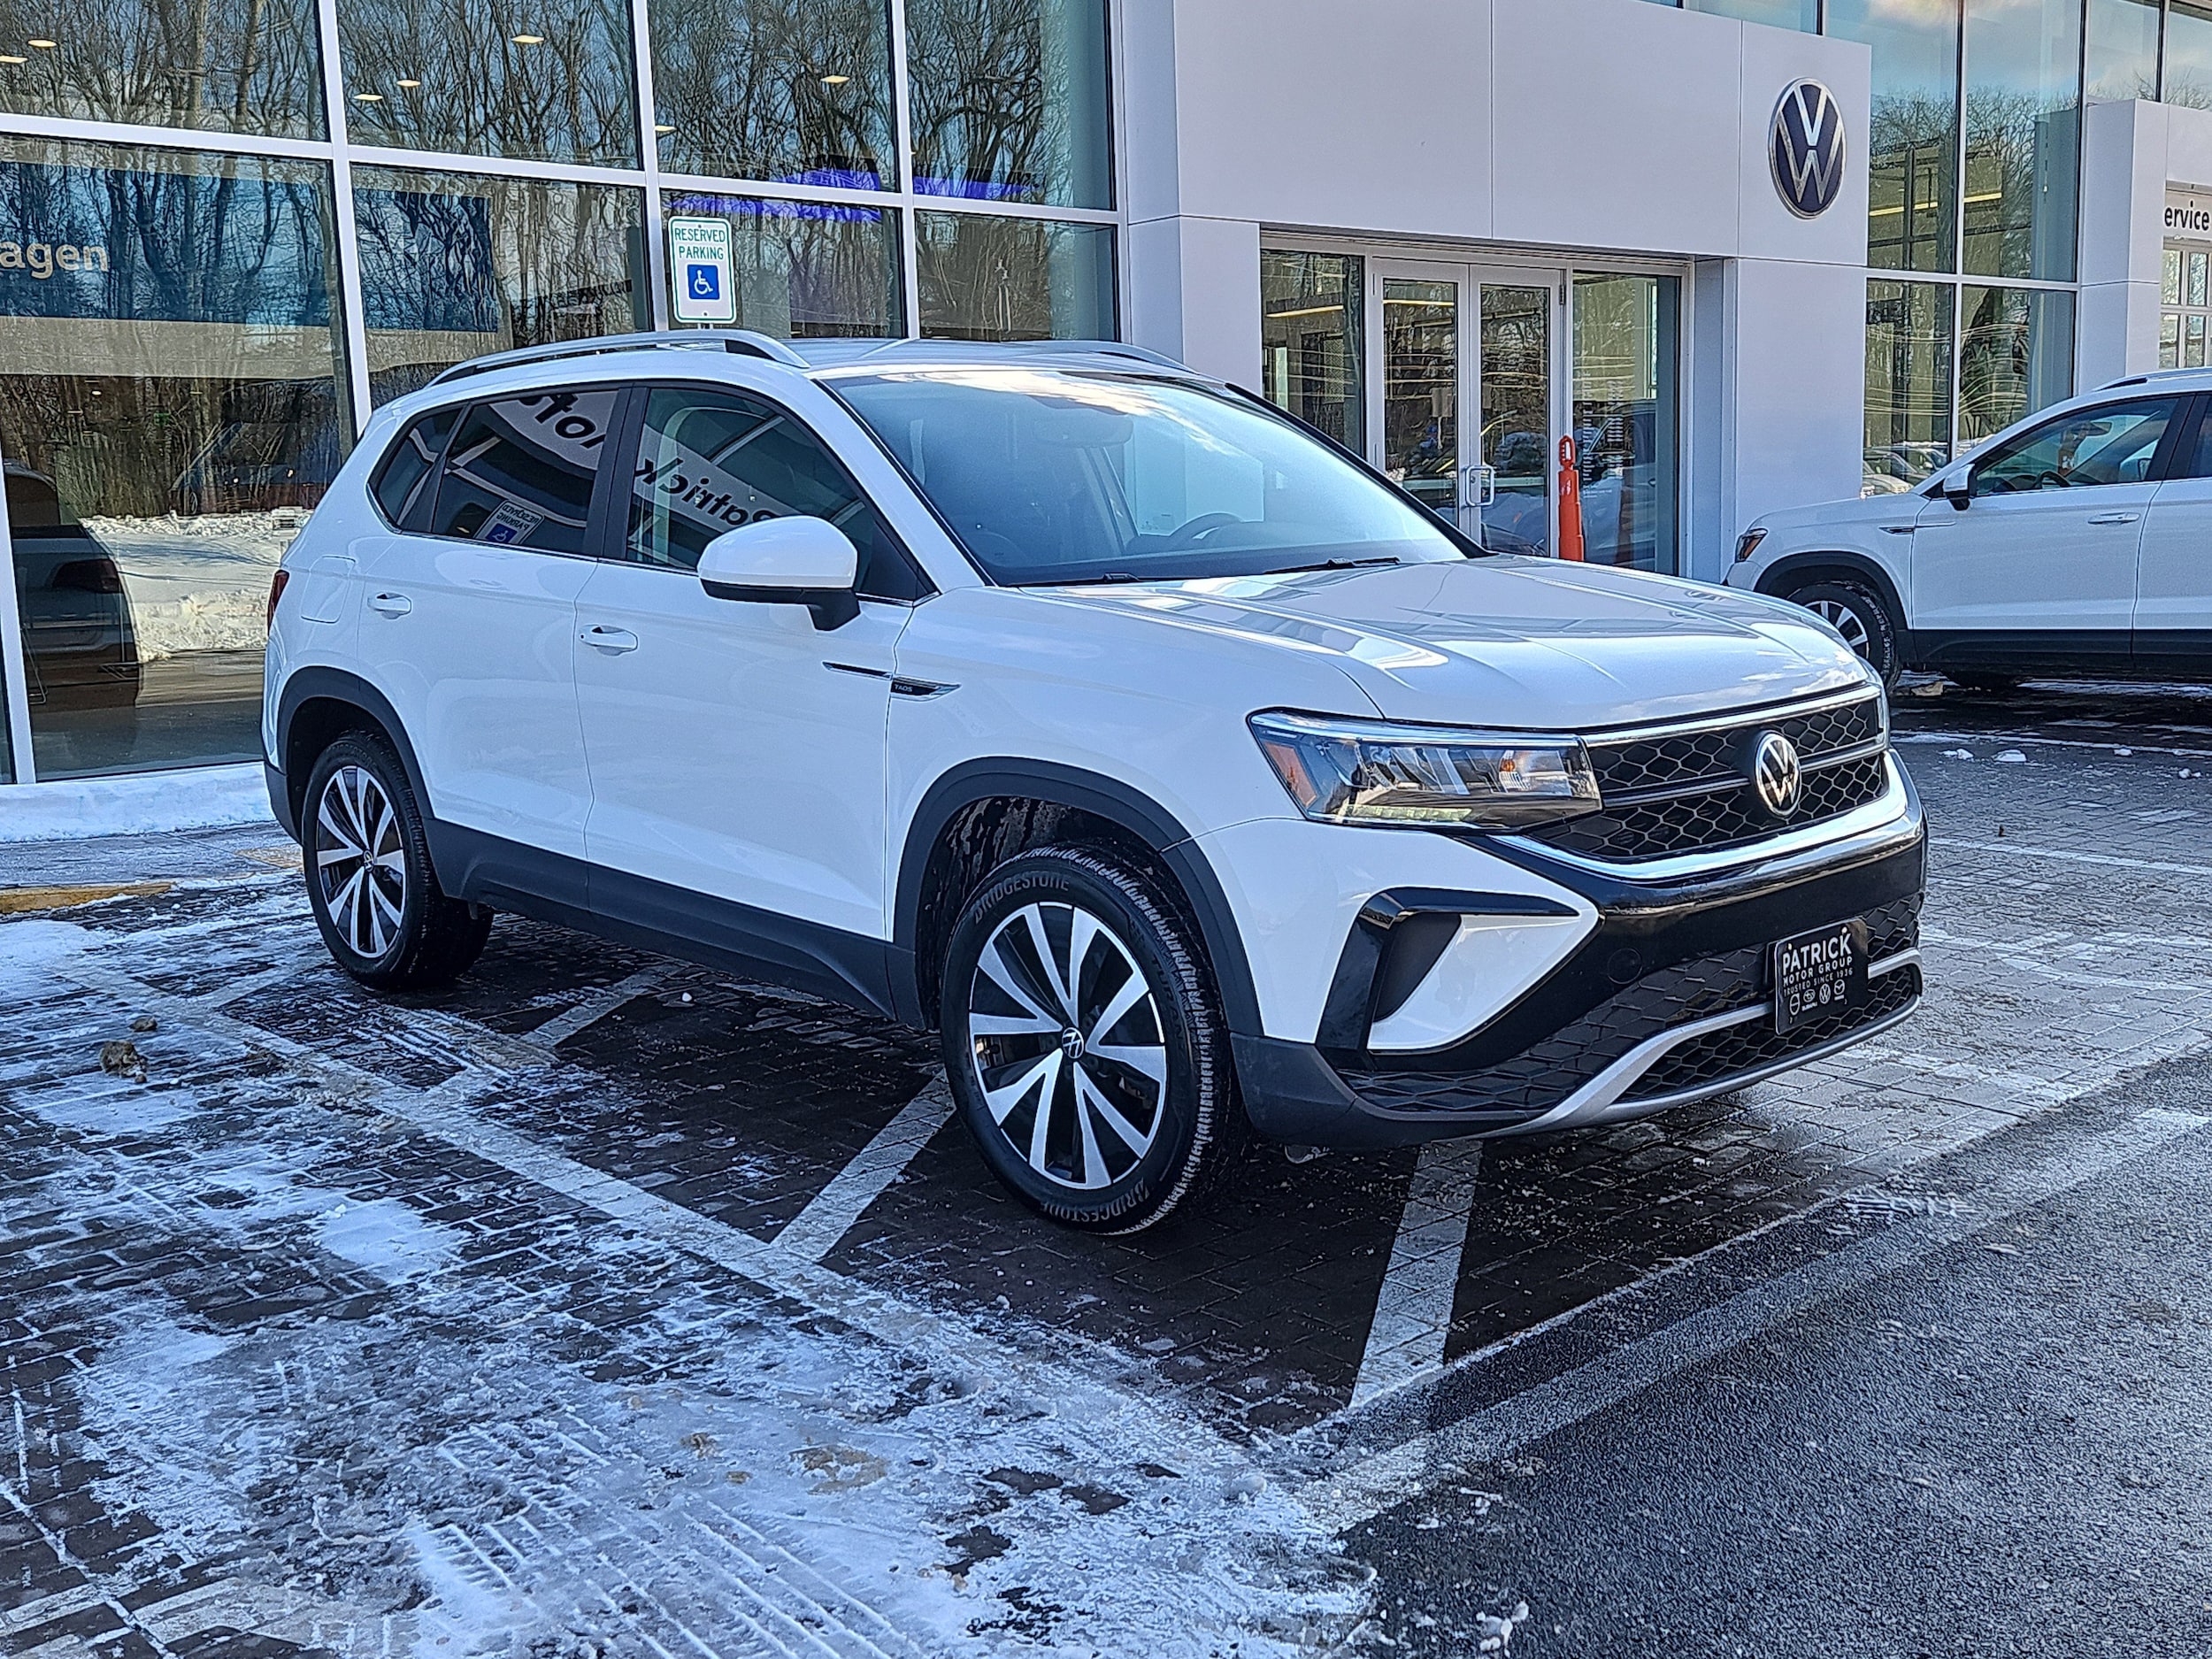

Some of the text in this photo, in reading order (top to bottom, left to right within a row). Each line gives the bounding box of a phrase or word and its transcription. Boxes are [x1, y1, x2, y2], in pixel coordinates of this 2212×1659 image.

[674, 227, 726, 242] RESERVED
[679, 245, 724, 260] PARKING
[974, 870, 1070, 924] BRIDGESTONE
[1782, 933, 1852, 976] PATRICK
[1783, 956, 1853, 988] MOTOR GROUP
[1783, 967, 1854, 997] TRUSTED SINCE 1936
[1040, 1177, 1150, 1223] BRIDGESTONE
